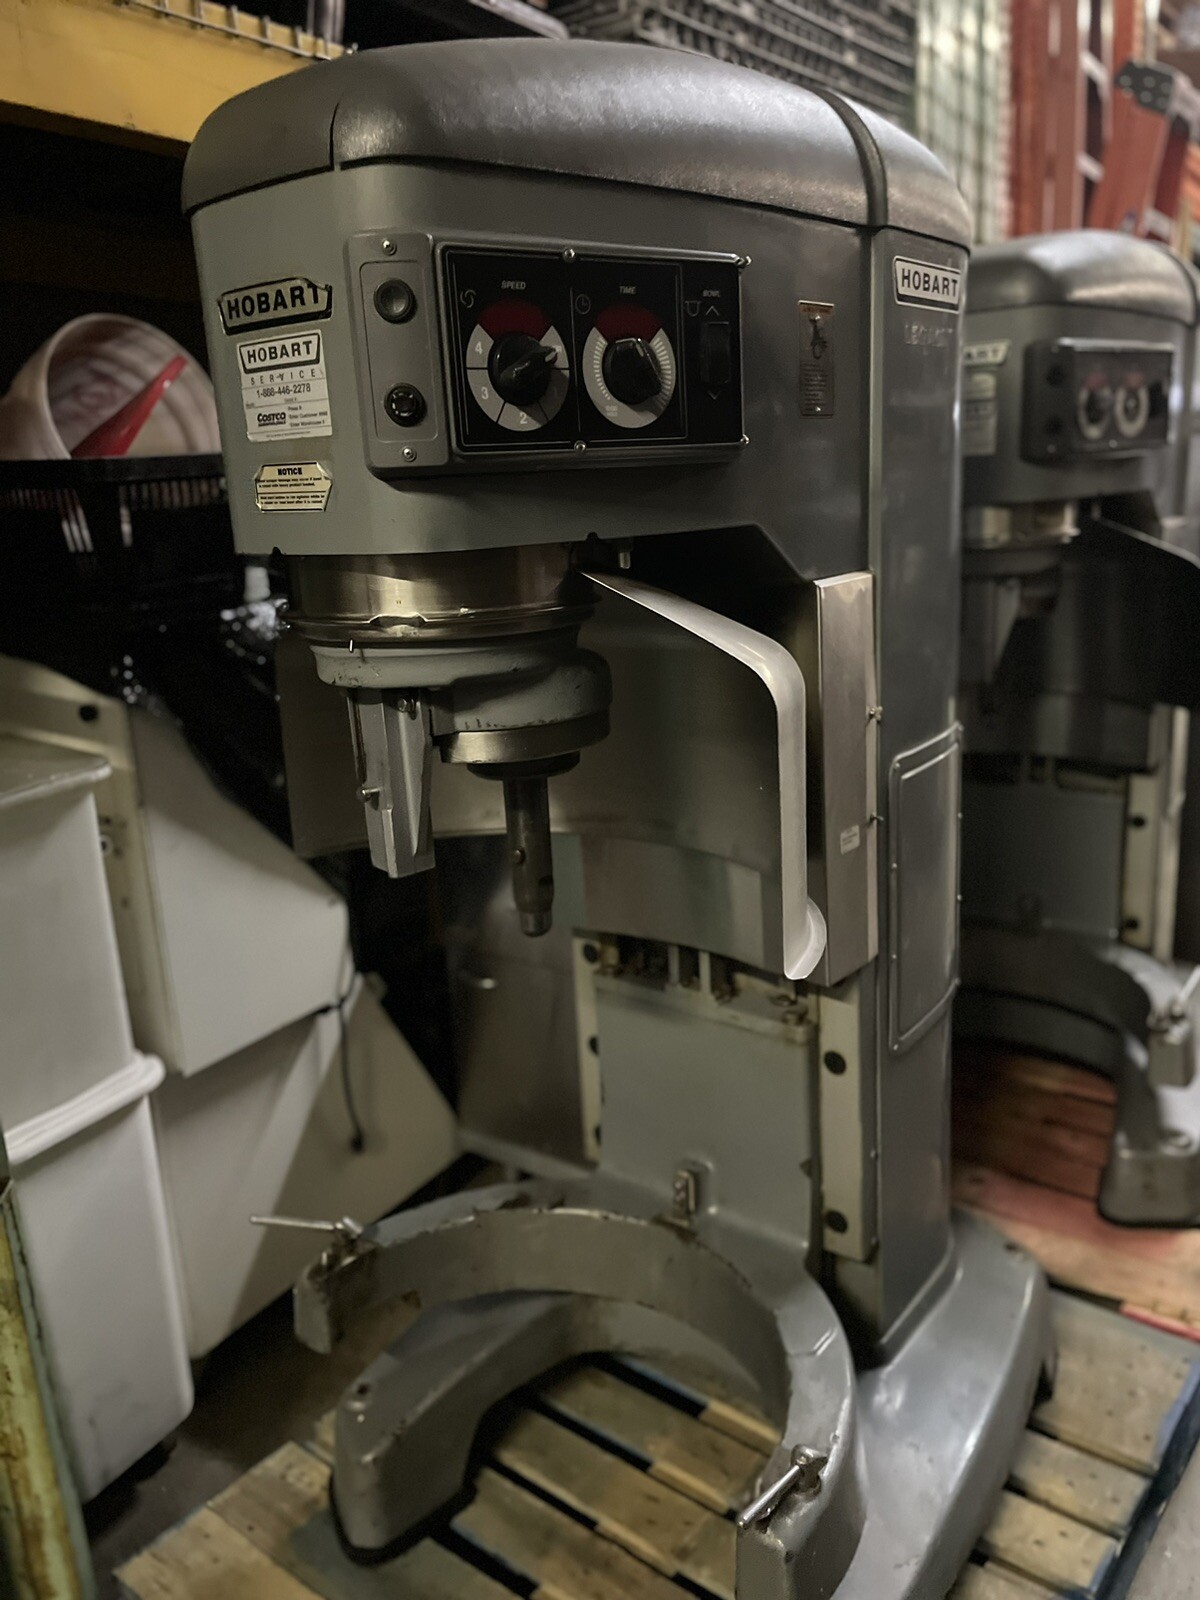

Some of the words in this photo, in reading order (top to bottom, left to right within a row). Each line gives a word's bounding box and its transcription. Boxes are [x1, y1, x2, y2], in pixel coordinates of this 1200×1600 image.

[501, 280, 527, 289] SPEED
[902, 268, 958, 297] HOBART
[619, 286, 637, 295] TIME
[703, 290, 721, 298] BOWL
[227, 283, 319, 320] HOBART
[247, 341, 312, 364] HOBART
[475, 341, 483, 355] 4
[251, 369, 316, 386] SERVICE
[257, 383, 311, 398] 1-888-446-2278
[481, 387, 489, 400] 3
[519, 412, 528, 424] 2
[277, 467, 303, 475] NOTICE
